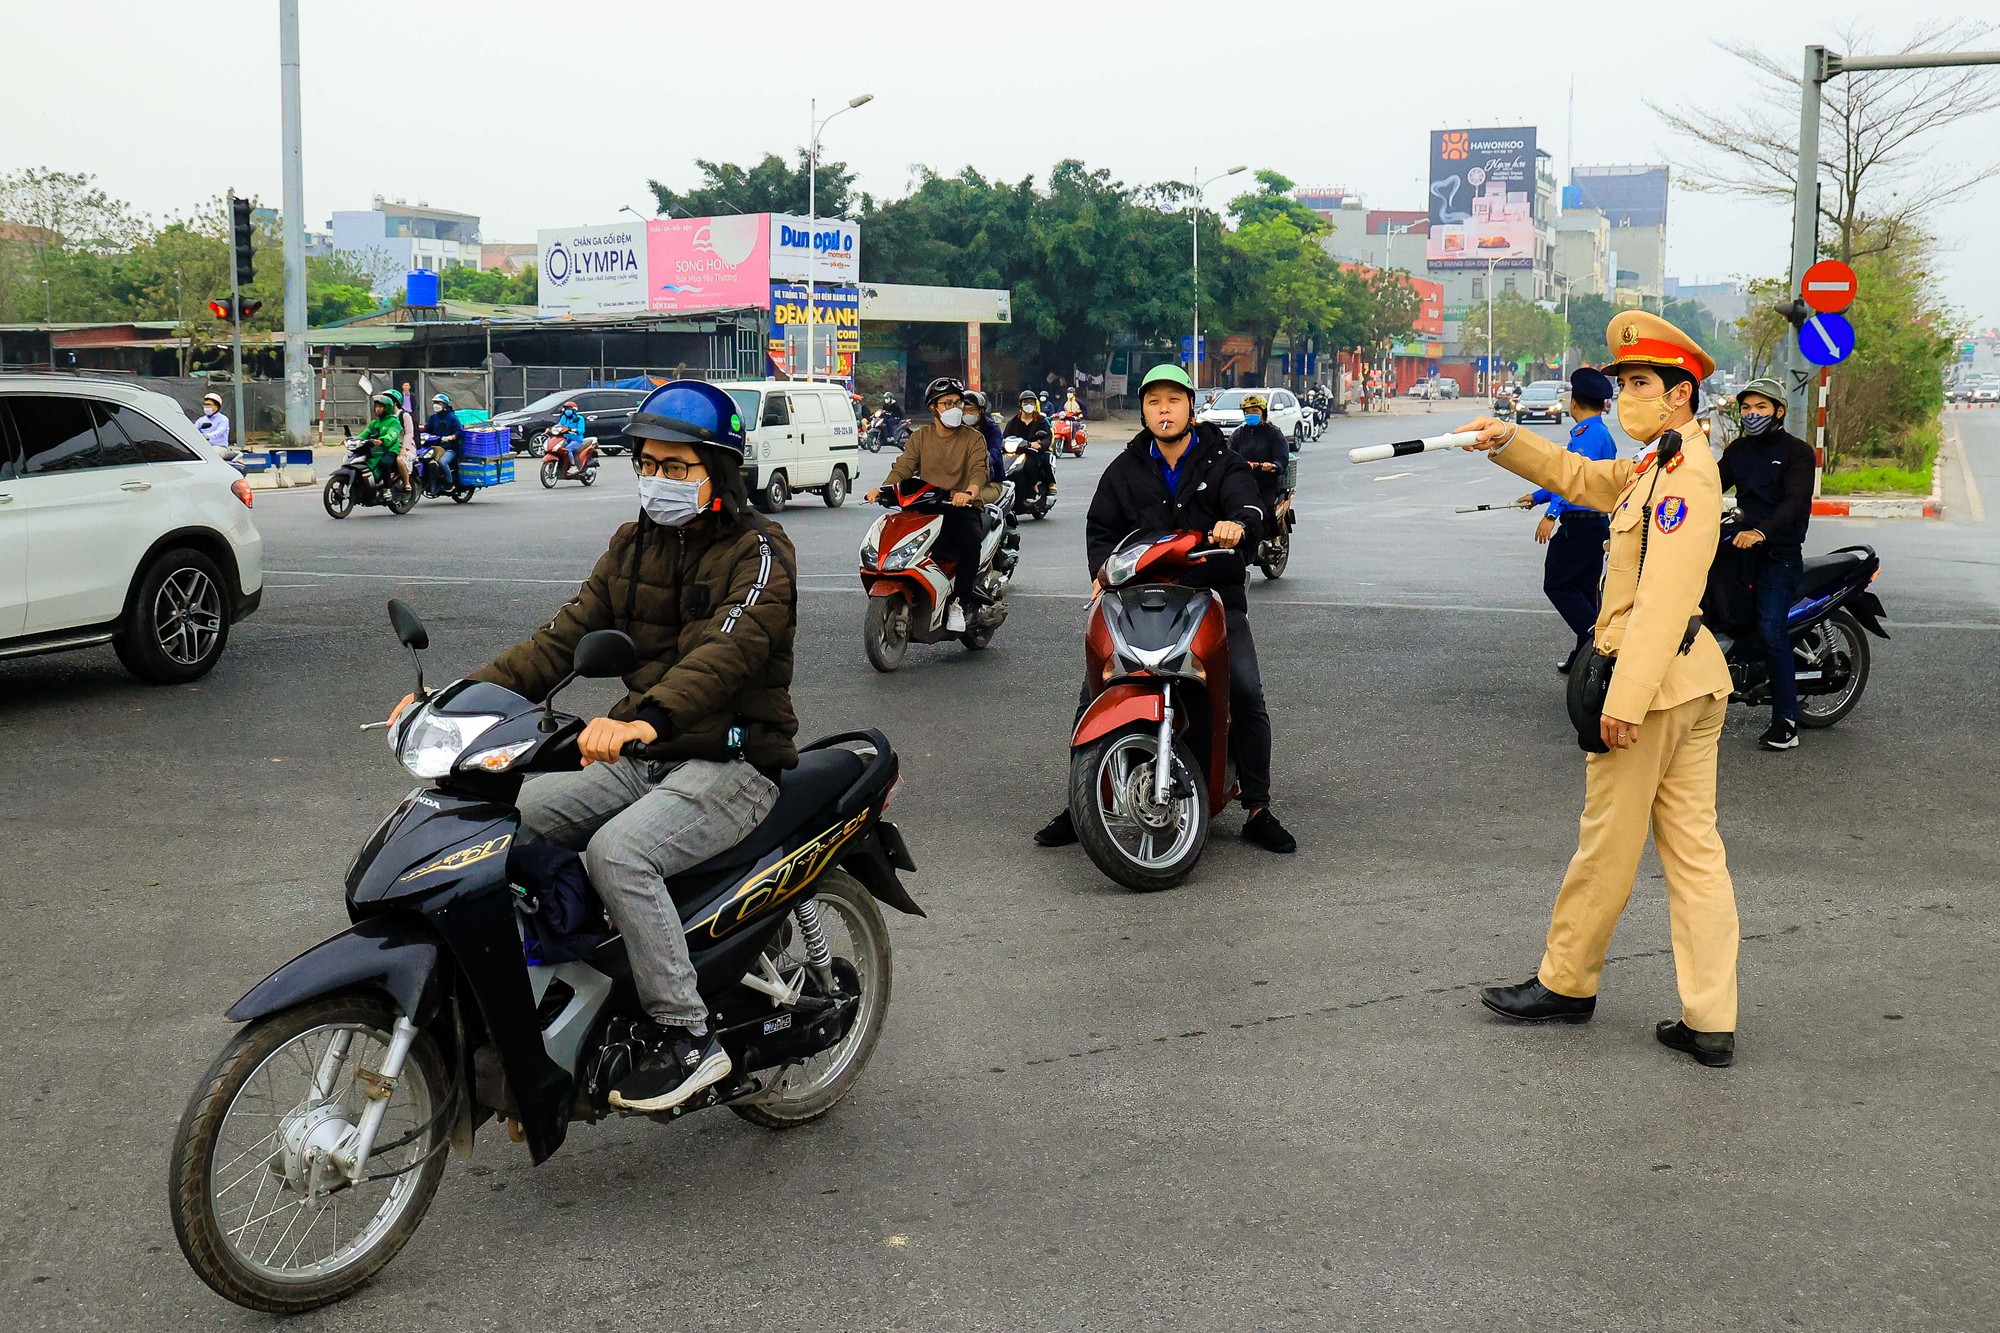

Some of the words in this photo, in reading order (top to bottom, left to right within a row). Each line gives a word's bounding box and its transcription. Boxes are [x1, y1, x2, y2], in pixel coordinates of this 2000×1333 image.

[1470, 140, 1524, 150] HAWONKOO
[592, 237, 602, 245] GA
[603, 232, 616, 245] GỐI
[827, 251, 852, 259] moments
